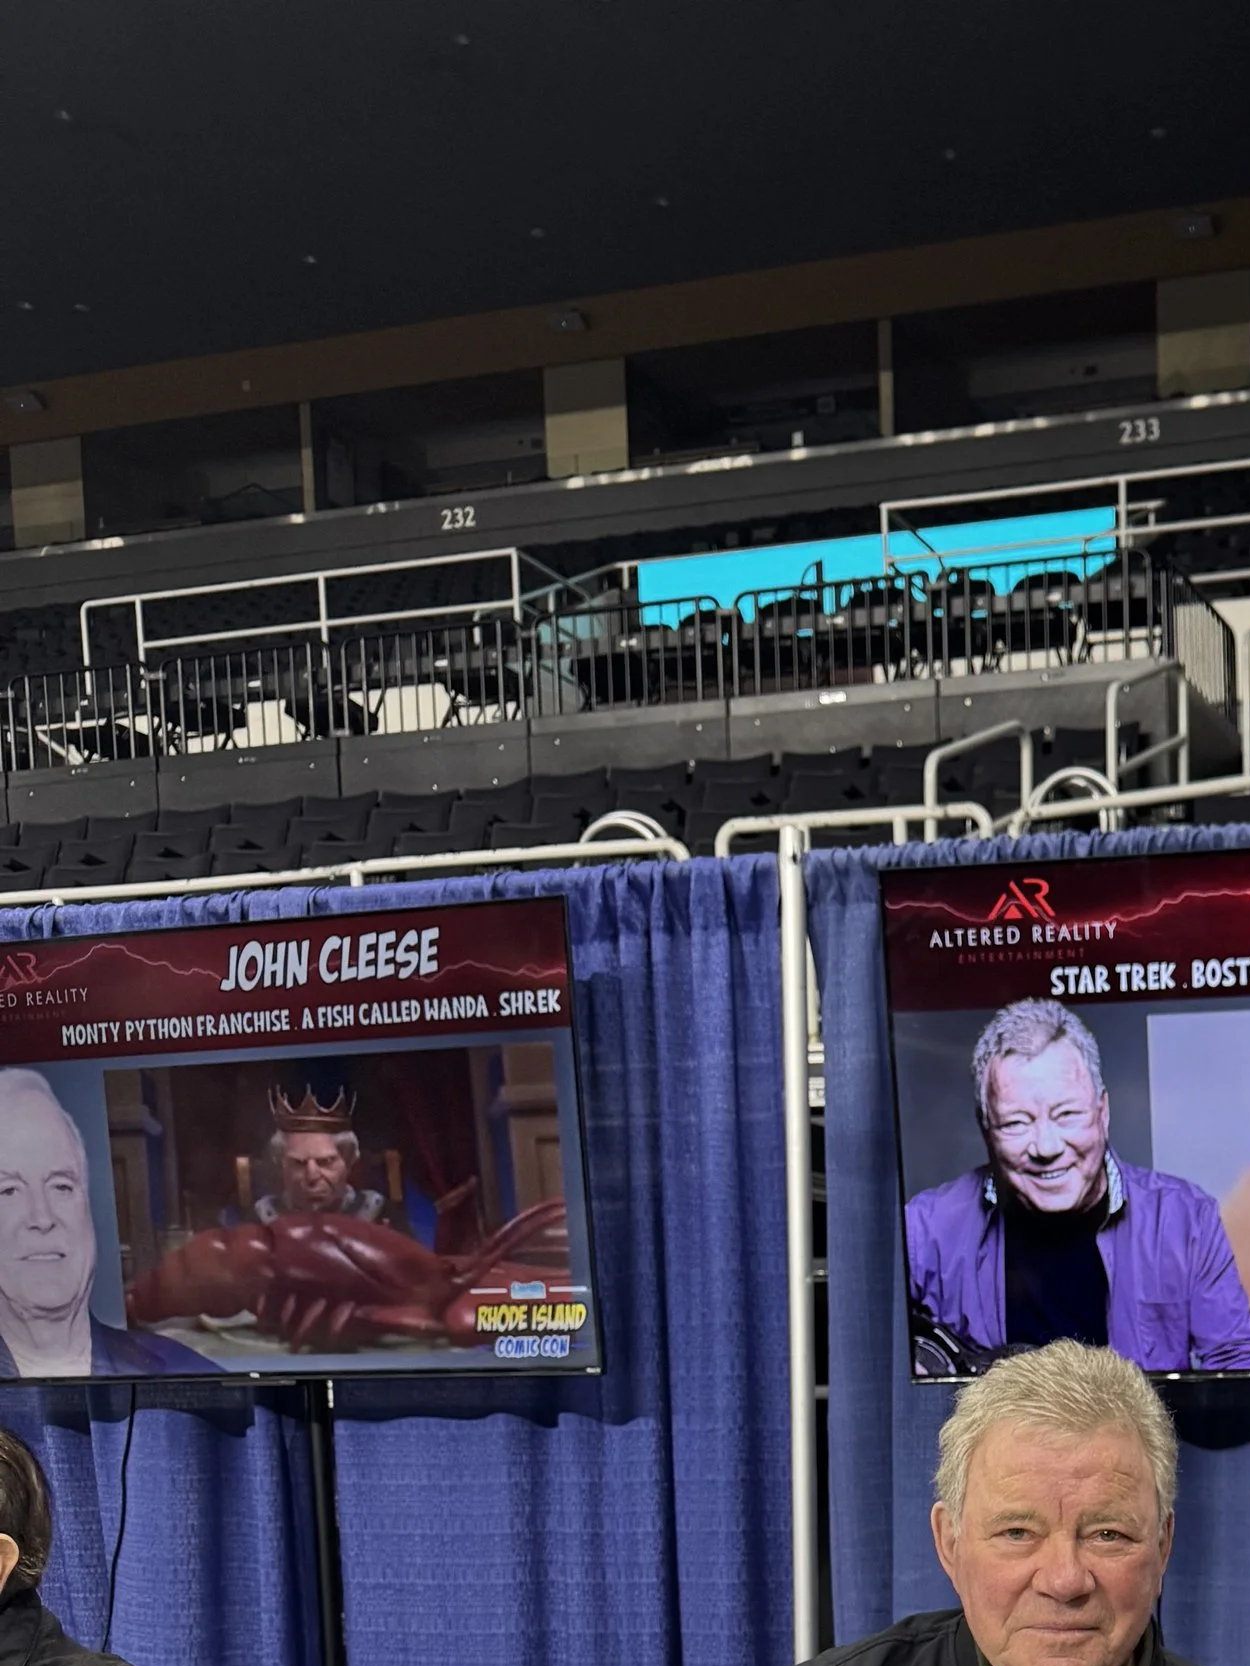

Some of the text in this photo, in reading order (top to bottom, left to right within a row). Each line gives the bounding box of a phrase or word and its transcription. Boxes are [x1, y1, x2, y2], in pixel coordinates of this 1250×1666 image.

[1119, 418, 1160, 445] 233
[441, 506, 476, 530] 232
[929, 921, 1117, 948] ALTERED REALITY
[219, 926, 440, 992] JOHN CLEESE
[1050, 965, 1111, 995] STAR
[1115, 961, 1176, 992] TREK
[26, 987, 88, 1006] REALITY
[62, 988, 562, 1046] MONTY PYTHON FRANCHISE A FISH CALLED WANDA SHREK
[477, 1303, 587, 1332] RHODE ISLAND
[495, 1335, 570, 1358] COMIC CON
